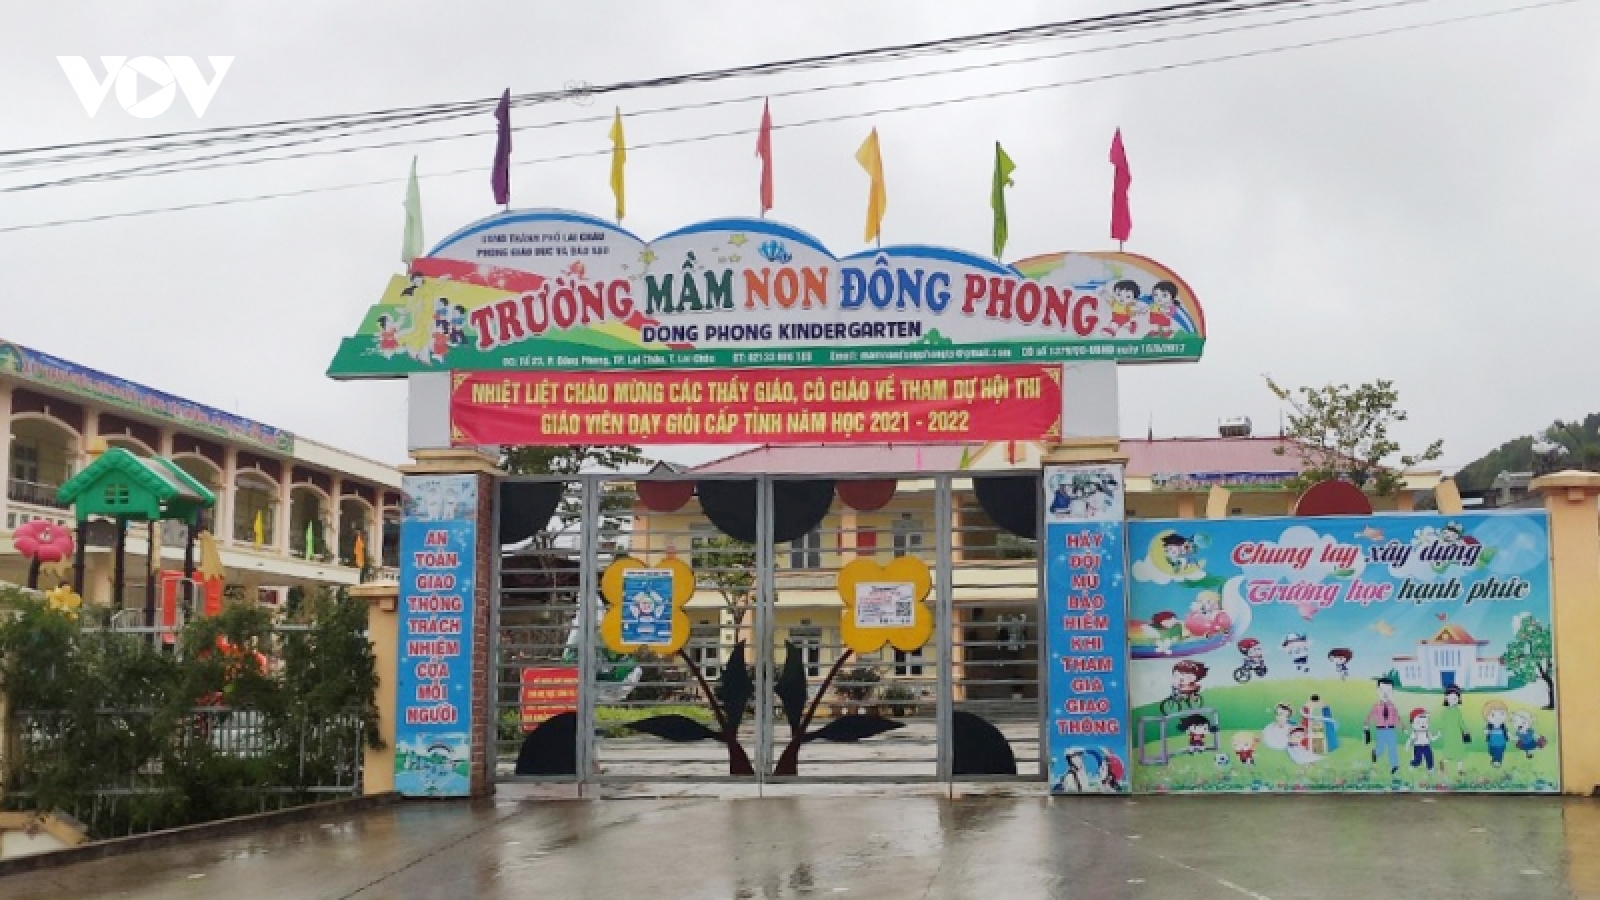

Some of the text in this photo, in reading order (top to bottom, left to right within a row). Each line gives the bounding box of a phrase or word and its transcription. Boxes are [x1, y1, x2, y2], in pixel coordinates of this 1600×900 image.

[470, 251, 1098, 348] TRƯỜNG MẦM NON ĐÔNG PHONG
[642, 320, 922, 343] DONG PHONG KINDERGARTEN
[472, 379, 521, 409] NHIỆT
[525, 378, 560, 409] LIỆT
[564, 378, 608, 404] CHÀO
[614, 378, 664, 404] MỪNG
[669, 378, 702, 403] CÁC
[754, 377, 798, 404] GIÁO,
[803, 376, 825, 402] CÔ
[830, 376, 868, 402] GIÁO
[900, 379, 948, 401] THAM
[953, 376, 978, 404] DỰ
[981, 374, 1009, 404] HỘI
[1015, 377, 1041, 399] THI
[541, 410, 580, 434] GIÁO
[585, 409, 624, 434] VIÊN
[628, 413, 662, 439] DẠY
[665, 406, 700, 434] GIỎI
[704, 405, 738, 434] CẤP
[743, 406, 782, 434] TỈNH
[787, 408, 826, 434] NĂM
[831, 412, 865, 439] HỌC
[870, 411, 909, 433] 2021
[928, 410, 969, 432] 2022
[425, 531, 448, 547] AN
[1066, 530, 1104, 548] HÃY
[415, 548, 458, 568] TOÀN
[1070, 550, 1100, 571] ĐỘI
[1232, 542, 1314, 570] Chung
[1363, 541, 1412, 568] xây
[1419, 539, 1482, 568] dựng
[417, 574, 455, 590] GIAO
[1071, 572, 1099, 590] MŨ
[1248, 576, 1529, 606] Trường học hạnh phúc
[408, 592, 462, 612] THÔNG
[1068, 590, 1105, 610] BẢO
[408, 615, 461, 633] TRÁCH
[1064, 609, 1108, 630] HIỂM
[1071, 636, 1103, 652] KHI
[1061, 656, 1113, 672] THAM
[1070, 678, 1105, 693] GIA
[407, 703, 457, 723] NGƯỜI
[1064, 698, 1110, 714] GIAO
[1057, 716, 1120, 734] THÔNG
